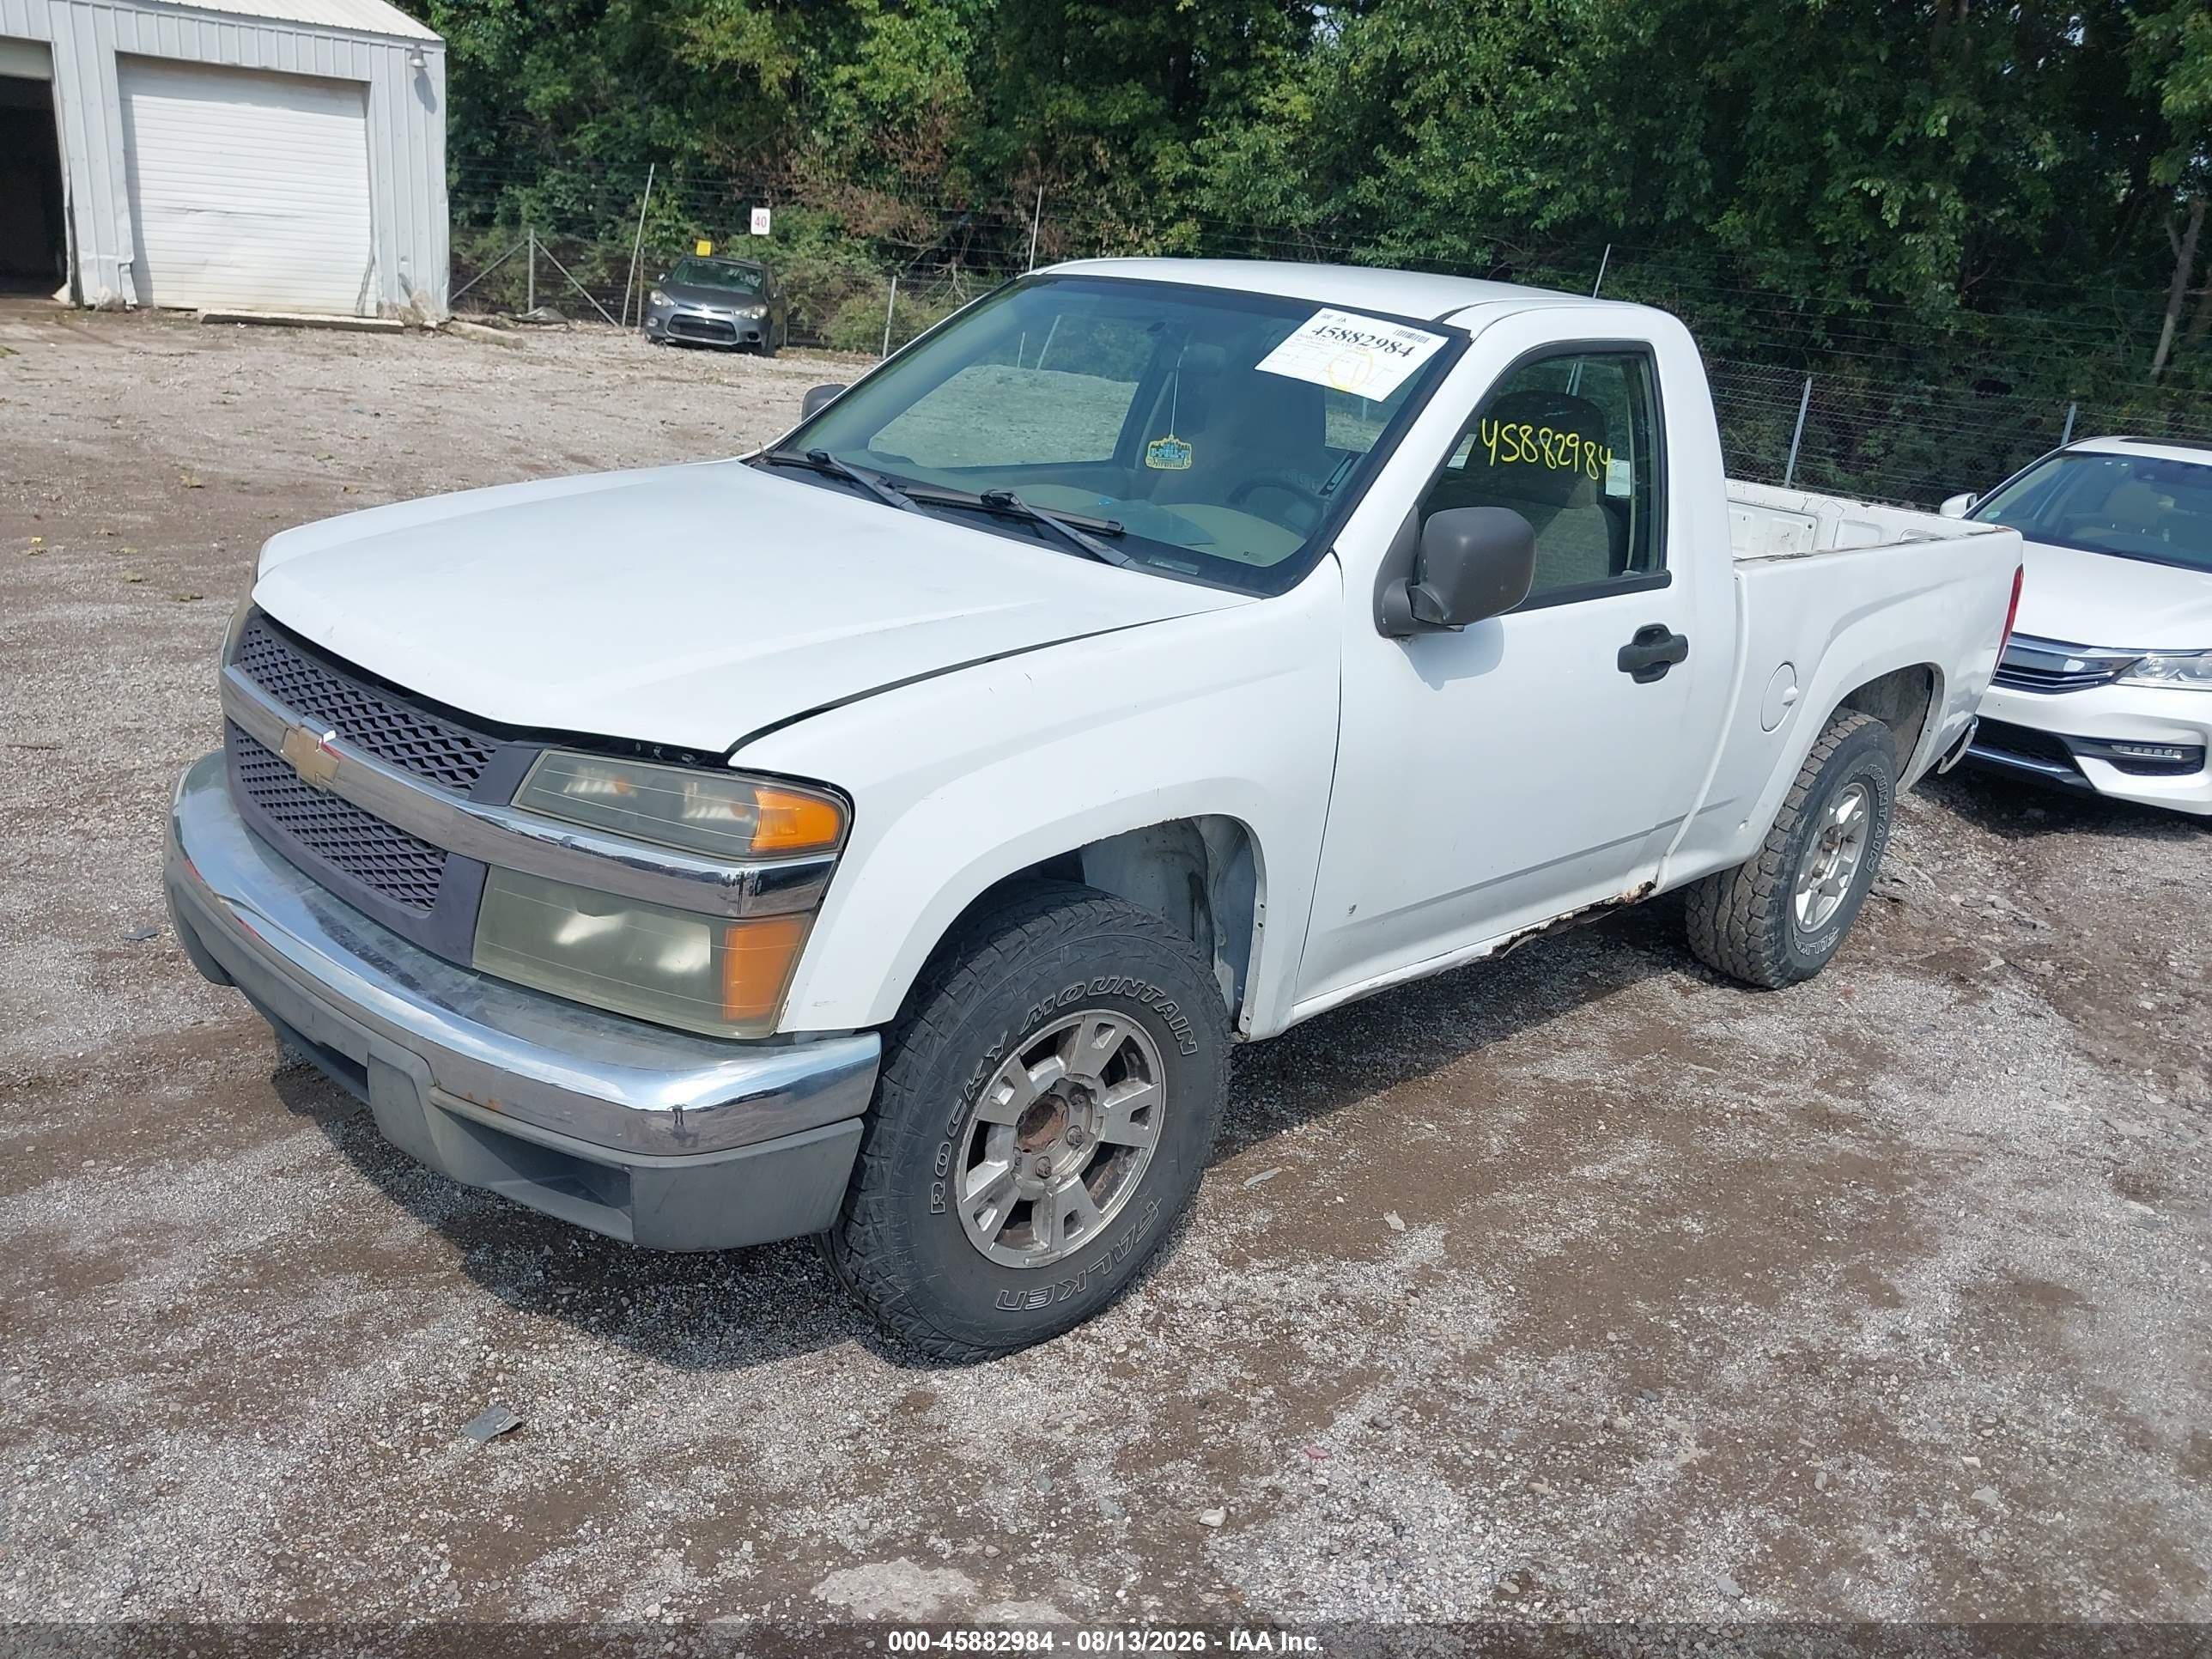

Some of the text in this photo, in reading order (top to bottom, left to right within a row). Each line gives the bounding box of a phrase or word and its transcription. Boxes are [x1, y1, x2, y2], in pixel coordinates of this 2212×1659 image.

[755, 216, 767, 228] 40
[1311, 325, 1416, 357] 45882984
[1481, 417, 1612, 481] 45882984
[930, 975, 1198, 1214] ROCKY MOUNTAIN
[995, 1198, 1162, 1311] FALKEN
